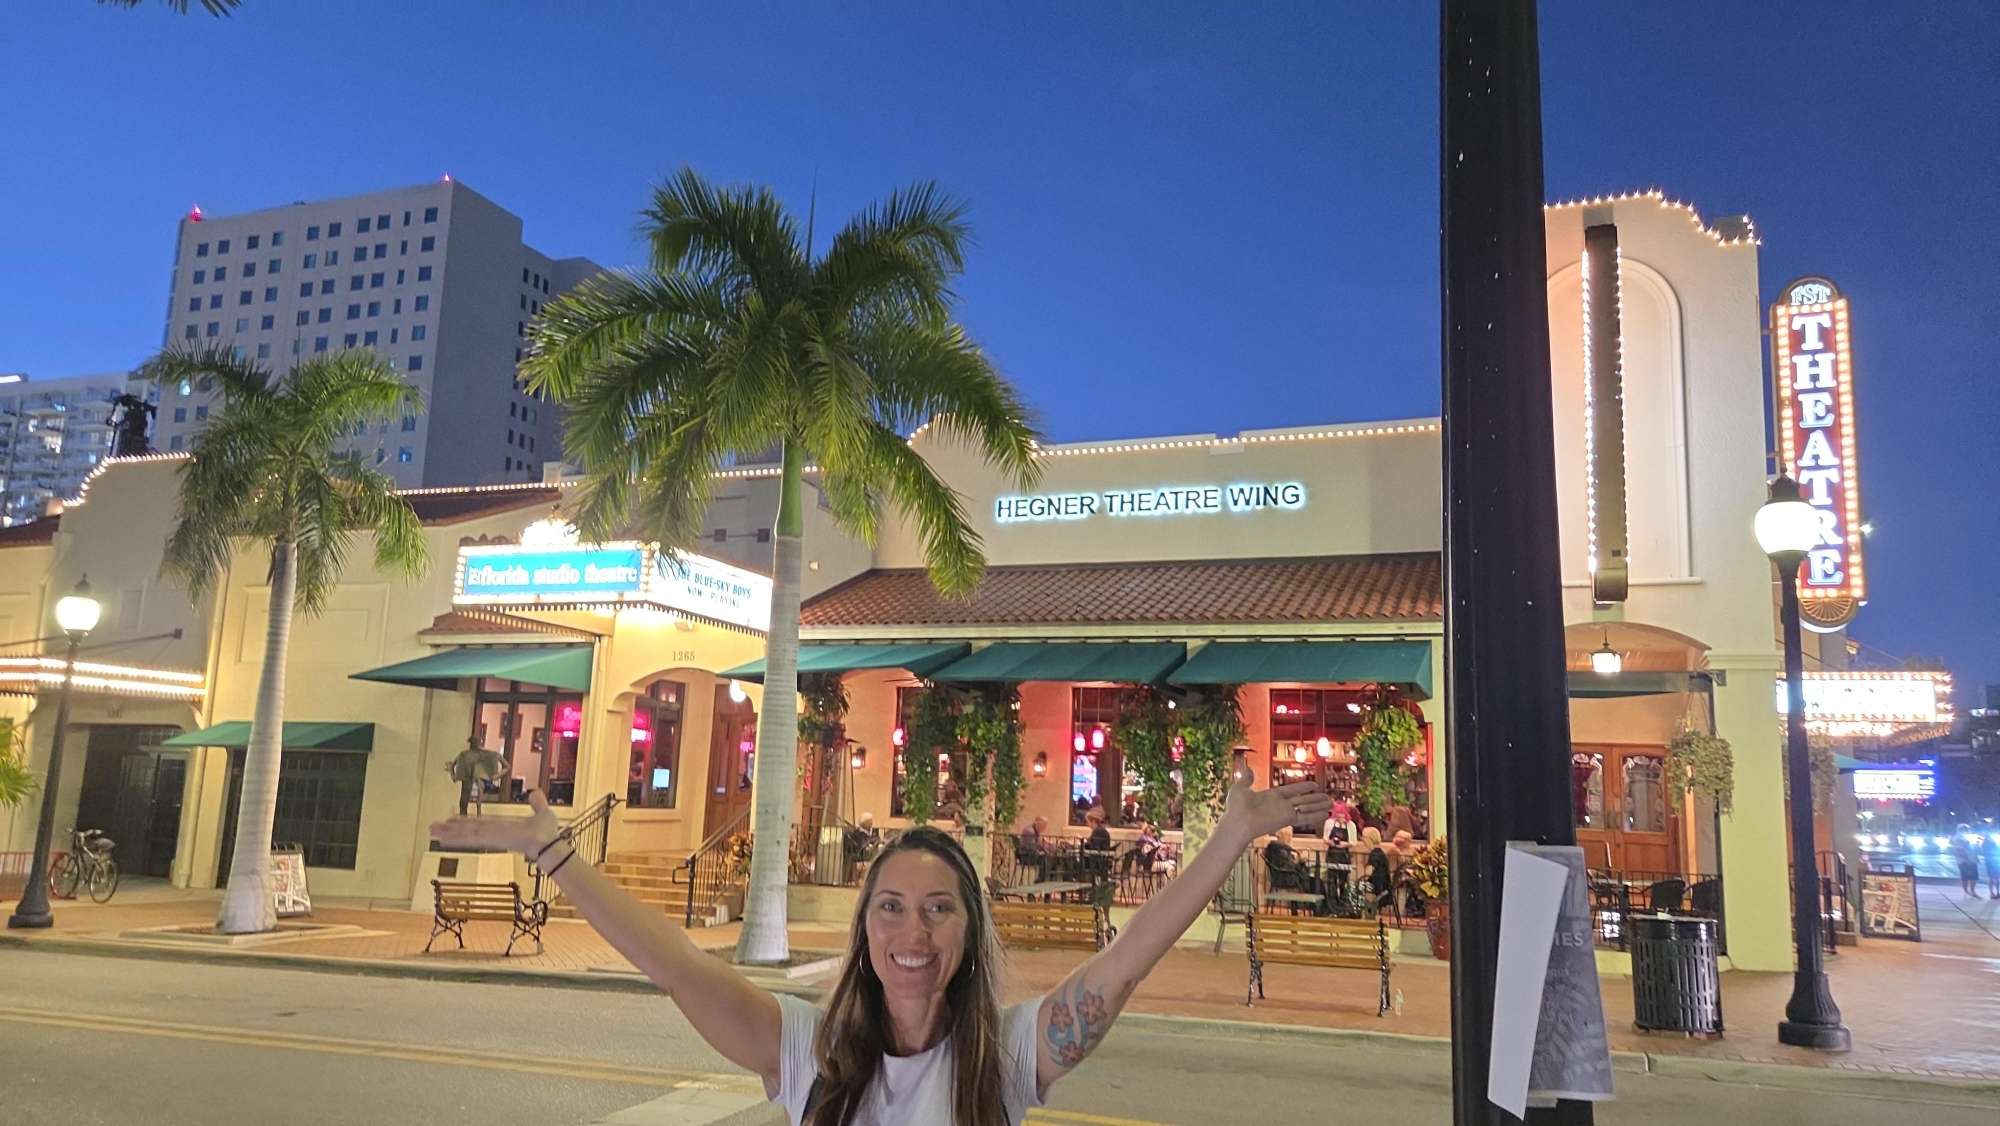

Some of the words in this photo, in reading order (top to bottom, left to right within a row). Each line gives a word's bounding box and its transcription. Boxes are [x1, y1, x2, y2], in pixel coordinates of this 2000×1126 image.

[1790, 284, 1831, 306] FST
[1791, 313, 1844, 585] THEATRE
[996, 495, 1096, 519] HEGNER
[1104, 488, 1219, 514] THEATRE
[1229, 484, 1300, 507] WING
[480, 563, 529, 586] florida
[532, 563, 581, 585] studio
[584, 562, 638, 583] theatre
[694, 573, 731, 593] BLUE-SKY
[732, 584, 752, 600] BOYS
[687, 586, 703, 597] NOW
